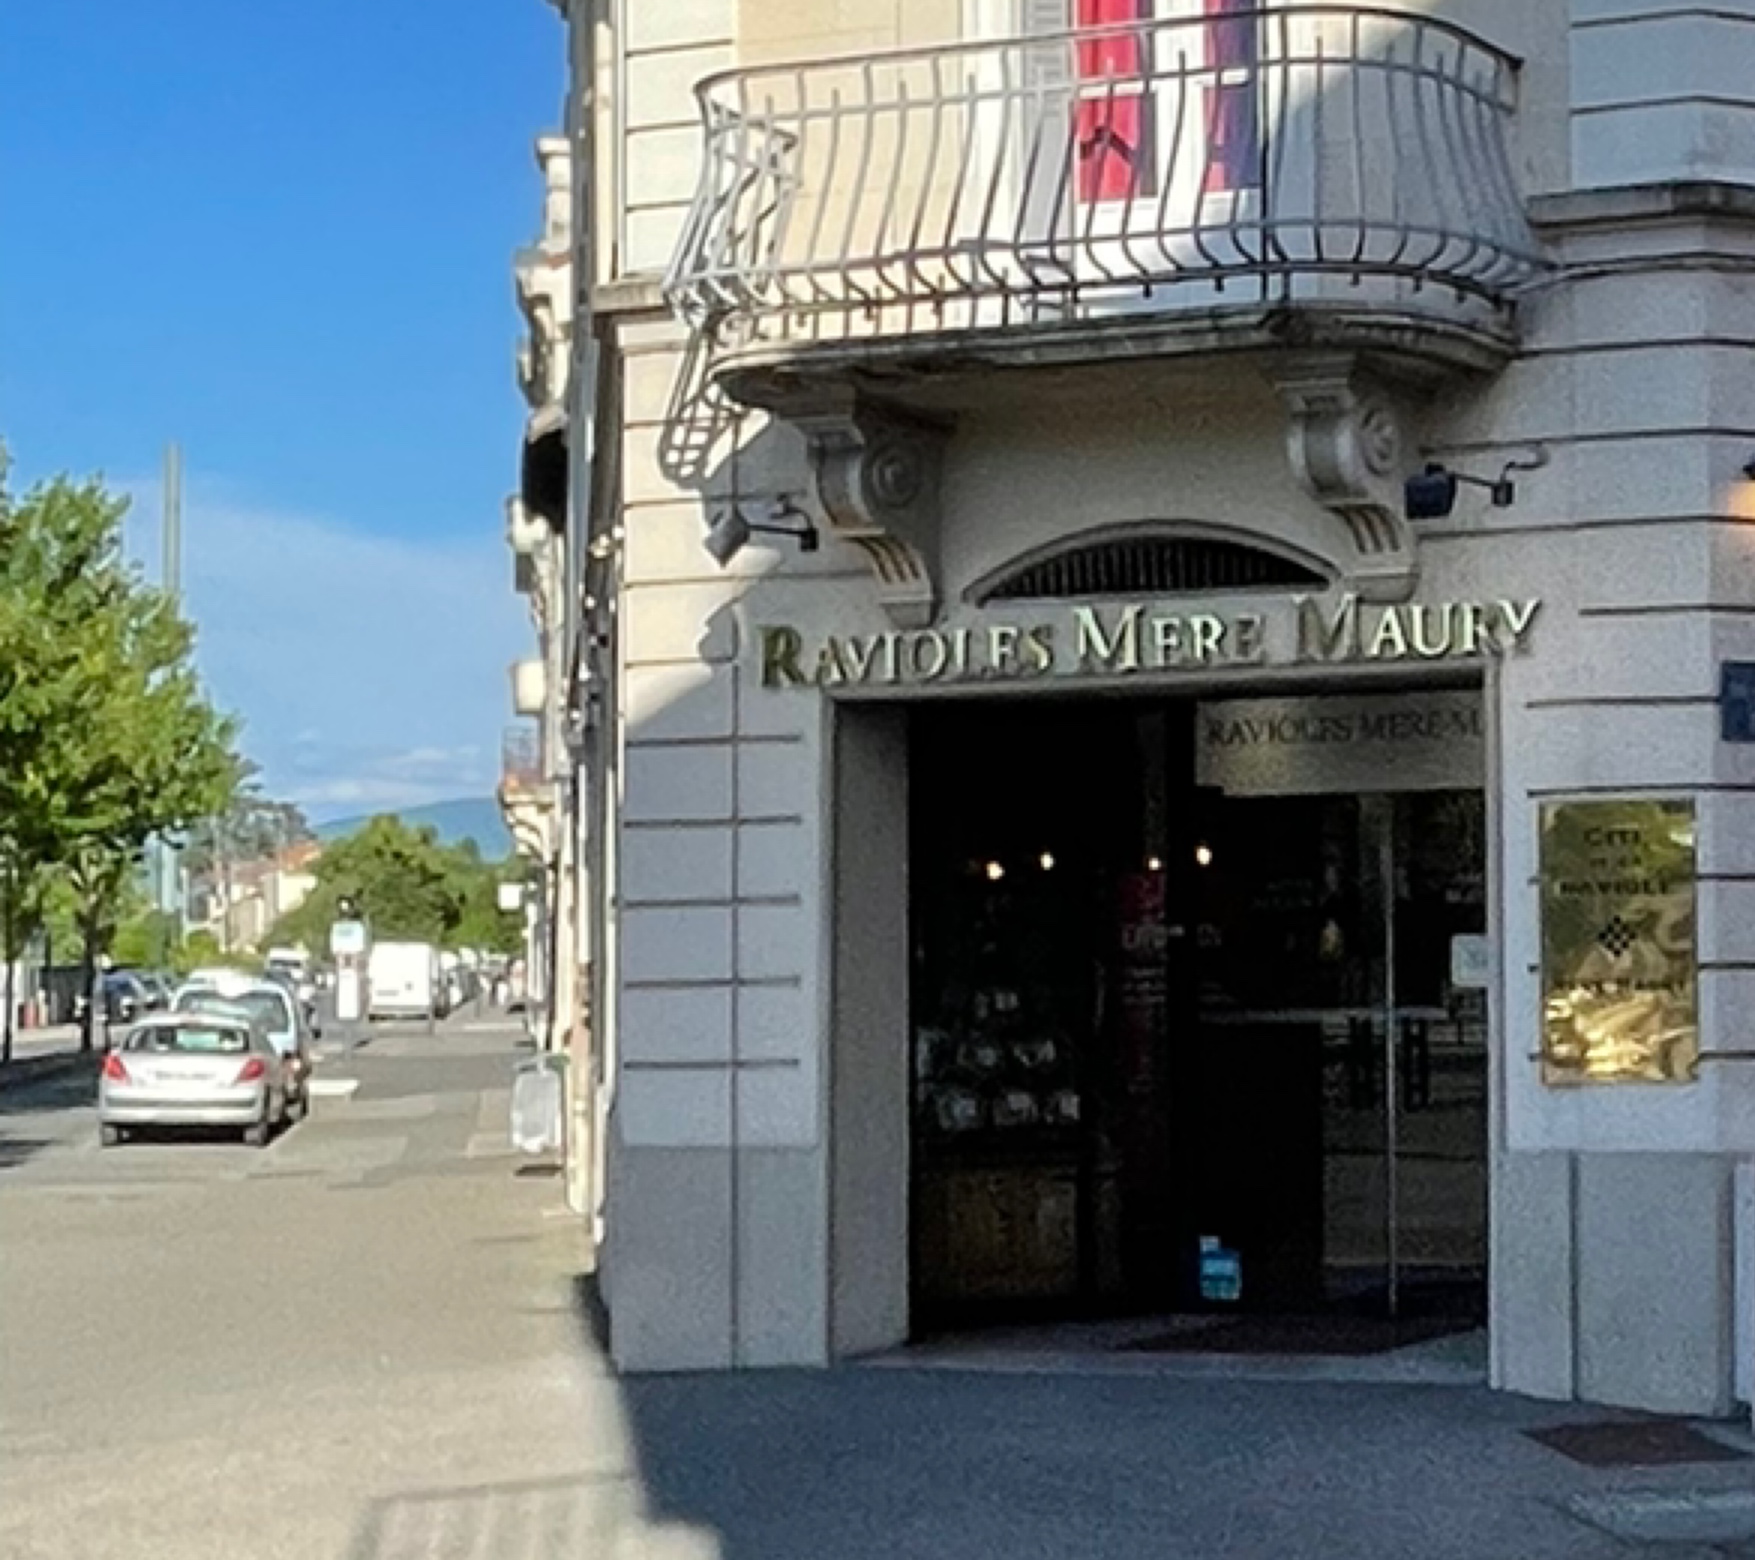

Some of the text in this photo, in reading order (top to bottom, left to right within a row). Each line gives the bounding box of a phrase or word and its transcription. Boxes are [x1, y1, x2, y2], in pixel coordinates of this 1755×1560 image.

[757, 591, 1542, 688] RAVIOLES MERE MAURY
